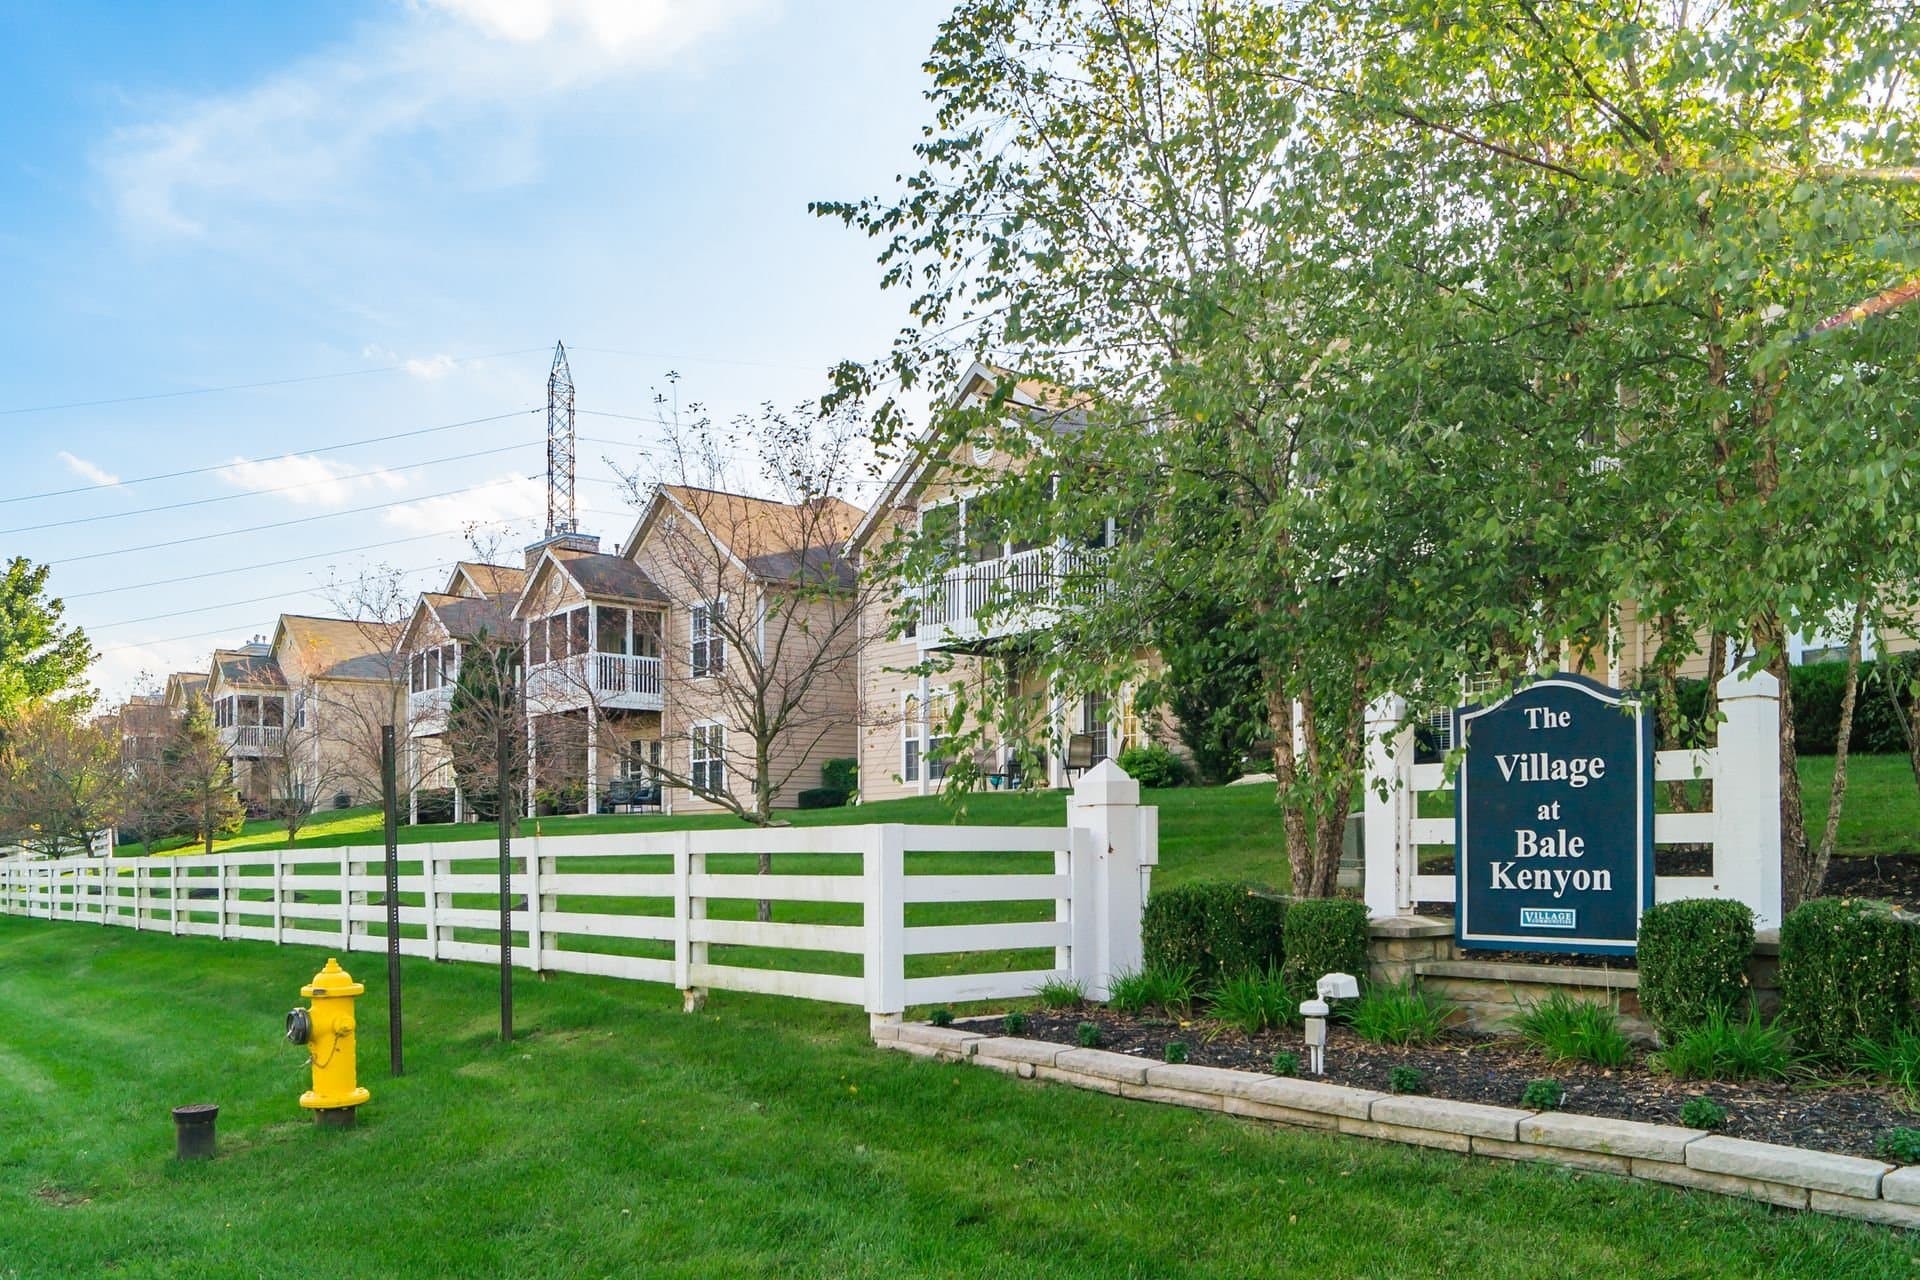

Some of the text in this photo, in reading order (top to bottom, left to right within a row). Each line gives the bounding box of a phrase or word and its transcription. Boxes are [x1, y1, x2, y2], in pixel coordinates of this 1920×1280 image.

[1524, 707, 1571, 729] The
[1494, 752, 1605, 787] Village
[1537, 801, 1561, 821] at
[1514, 829, 1584, 858] Bale
[1489, 862, 1612, 898] Kenyon
